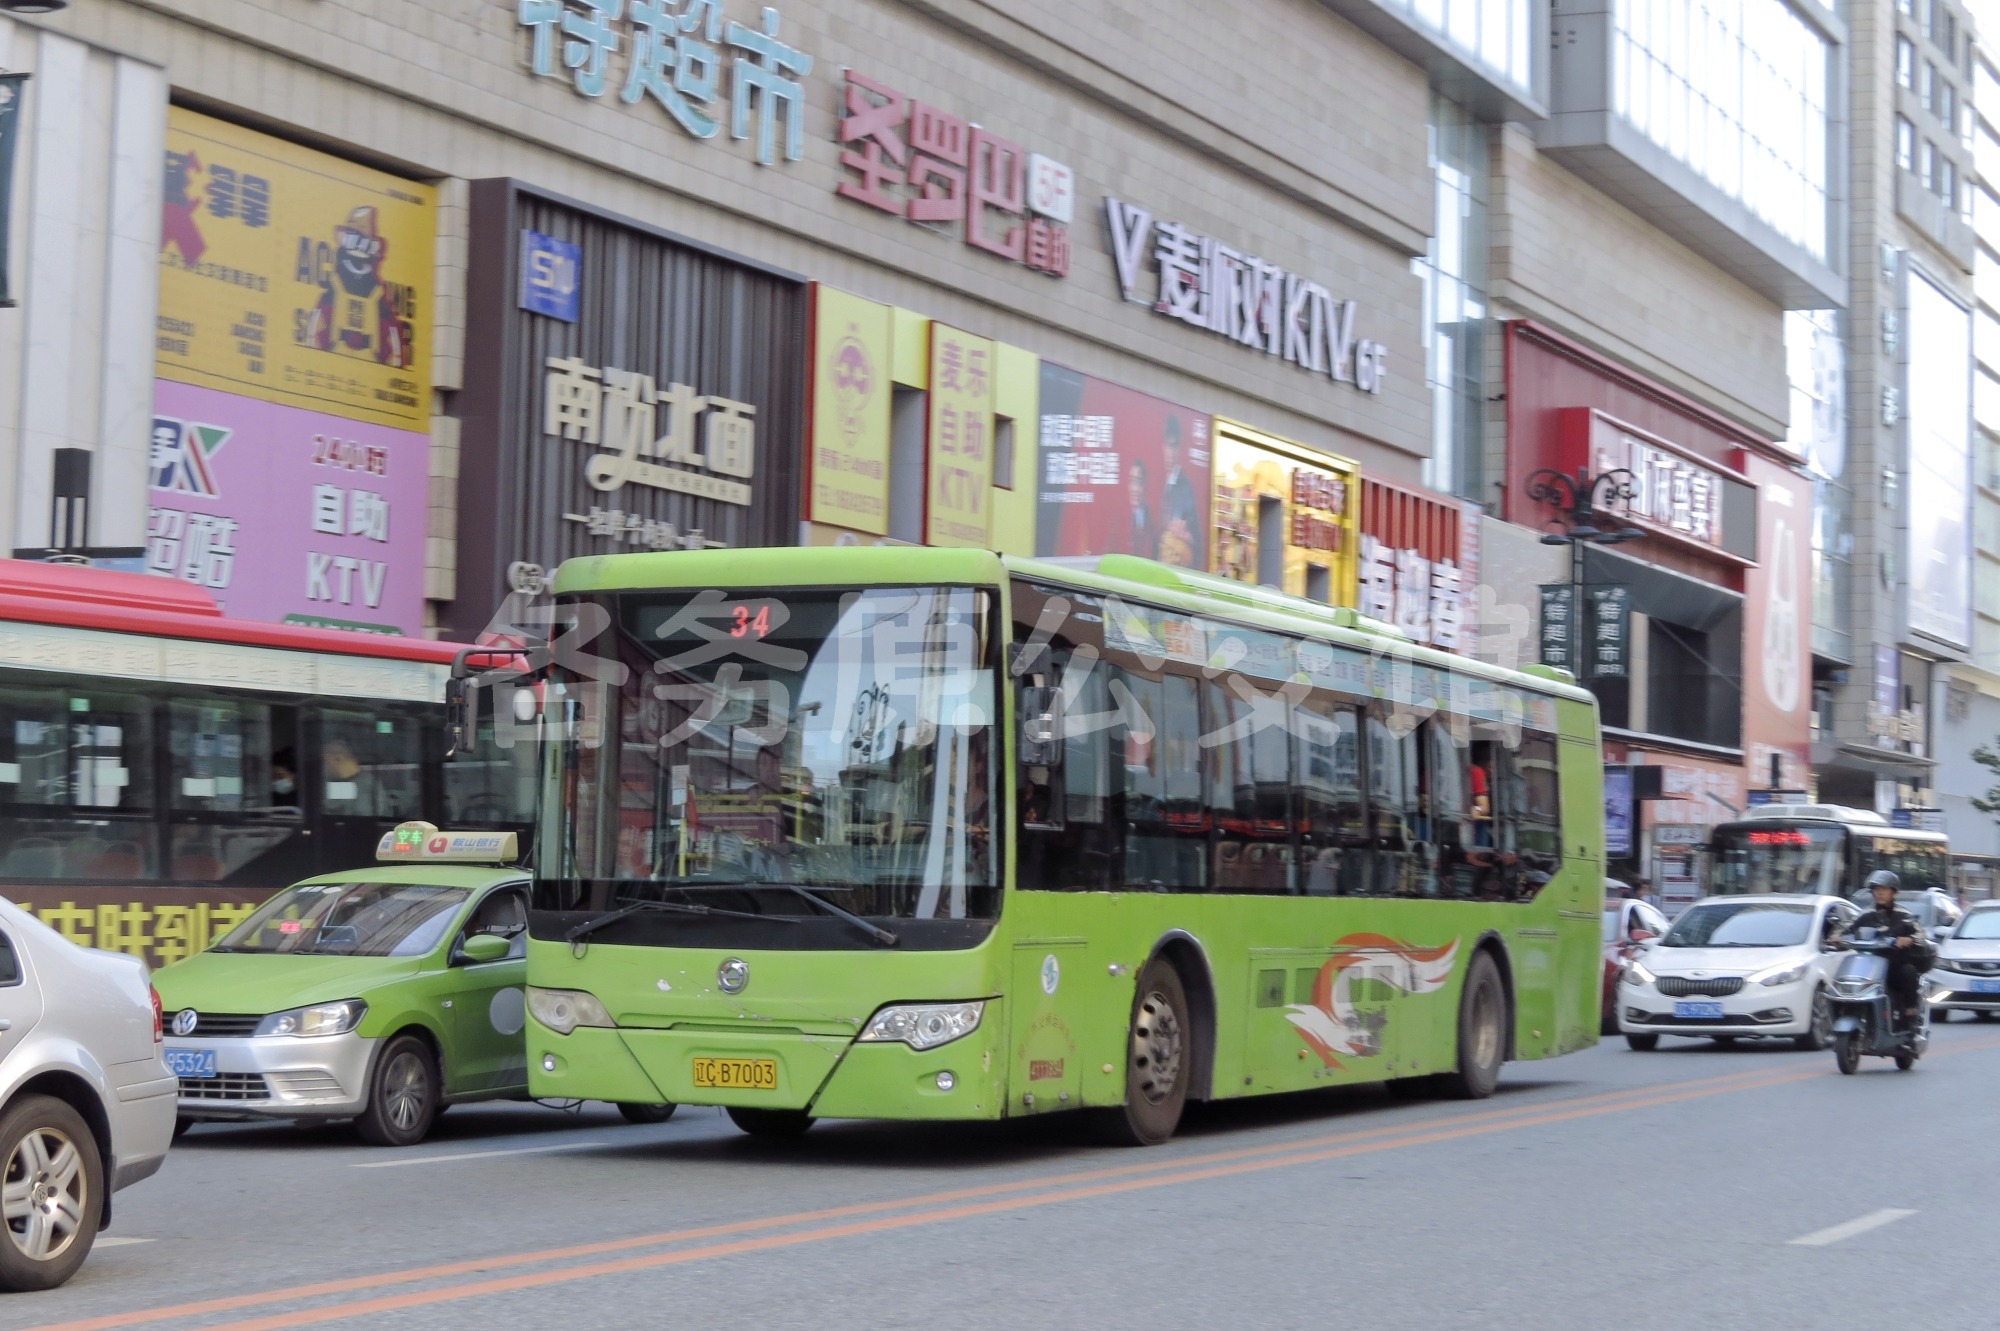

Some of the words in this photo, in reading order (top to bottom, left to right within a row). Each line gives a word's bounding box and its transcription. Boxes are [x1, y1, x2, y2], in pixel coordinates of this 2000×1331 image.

[311, 482, 390, 543] 自助
[306, 550, 388, 609] KTV
[730, 605, 770, 638] 34
[397, 829, 423, 846] 空车
[167, 1053, 214, 1073] 95324
